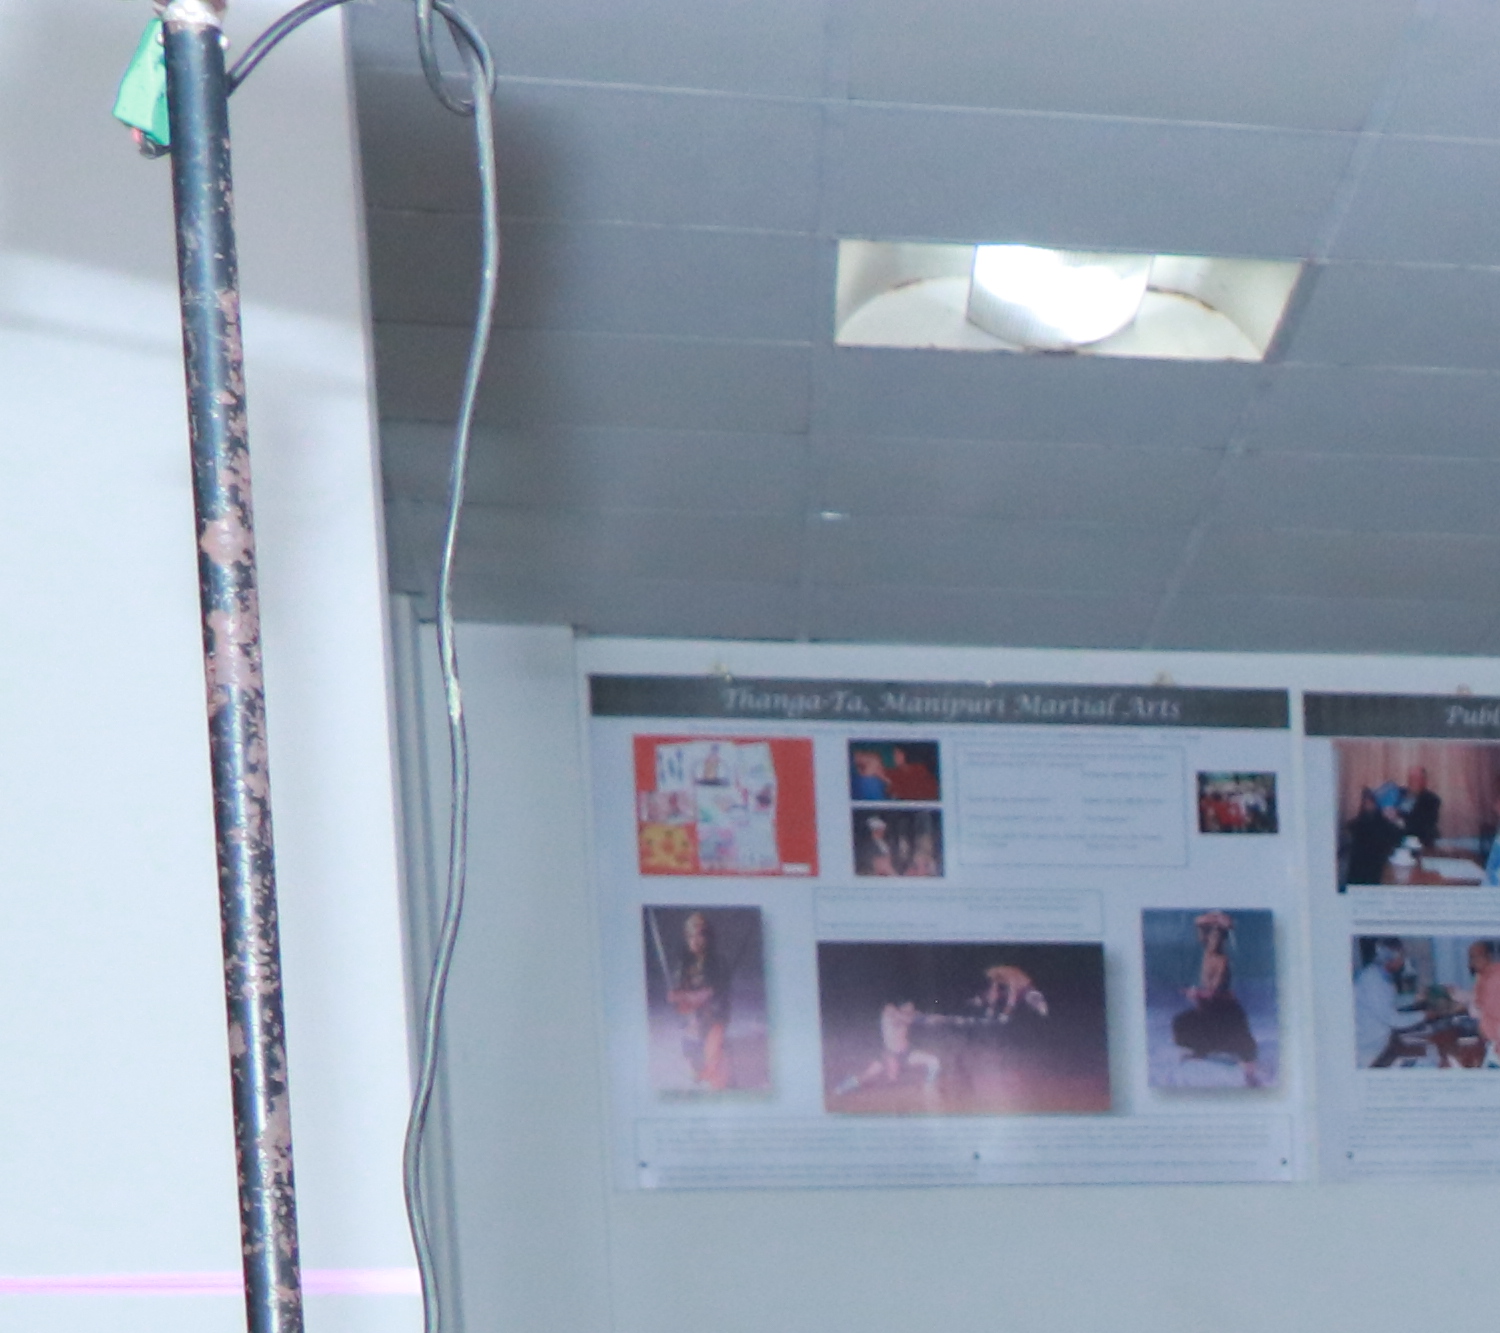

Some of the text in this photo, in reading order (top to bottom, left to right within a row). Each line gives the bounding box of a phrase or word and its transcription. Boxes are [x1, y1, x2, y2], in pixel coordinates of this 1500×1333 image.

[880, 690, 1005, 719] Manipuri
[1014, 692, 1115, 717] Martial
[1122, 694, 1181, 718] Arts
